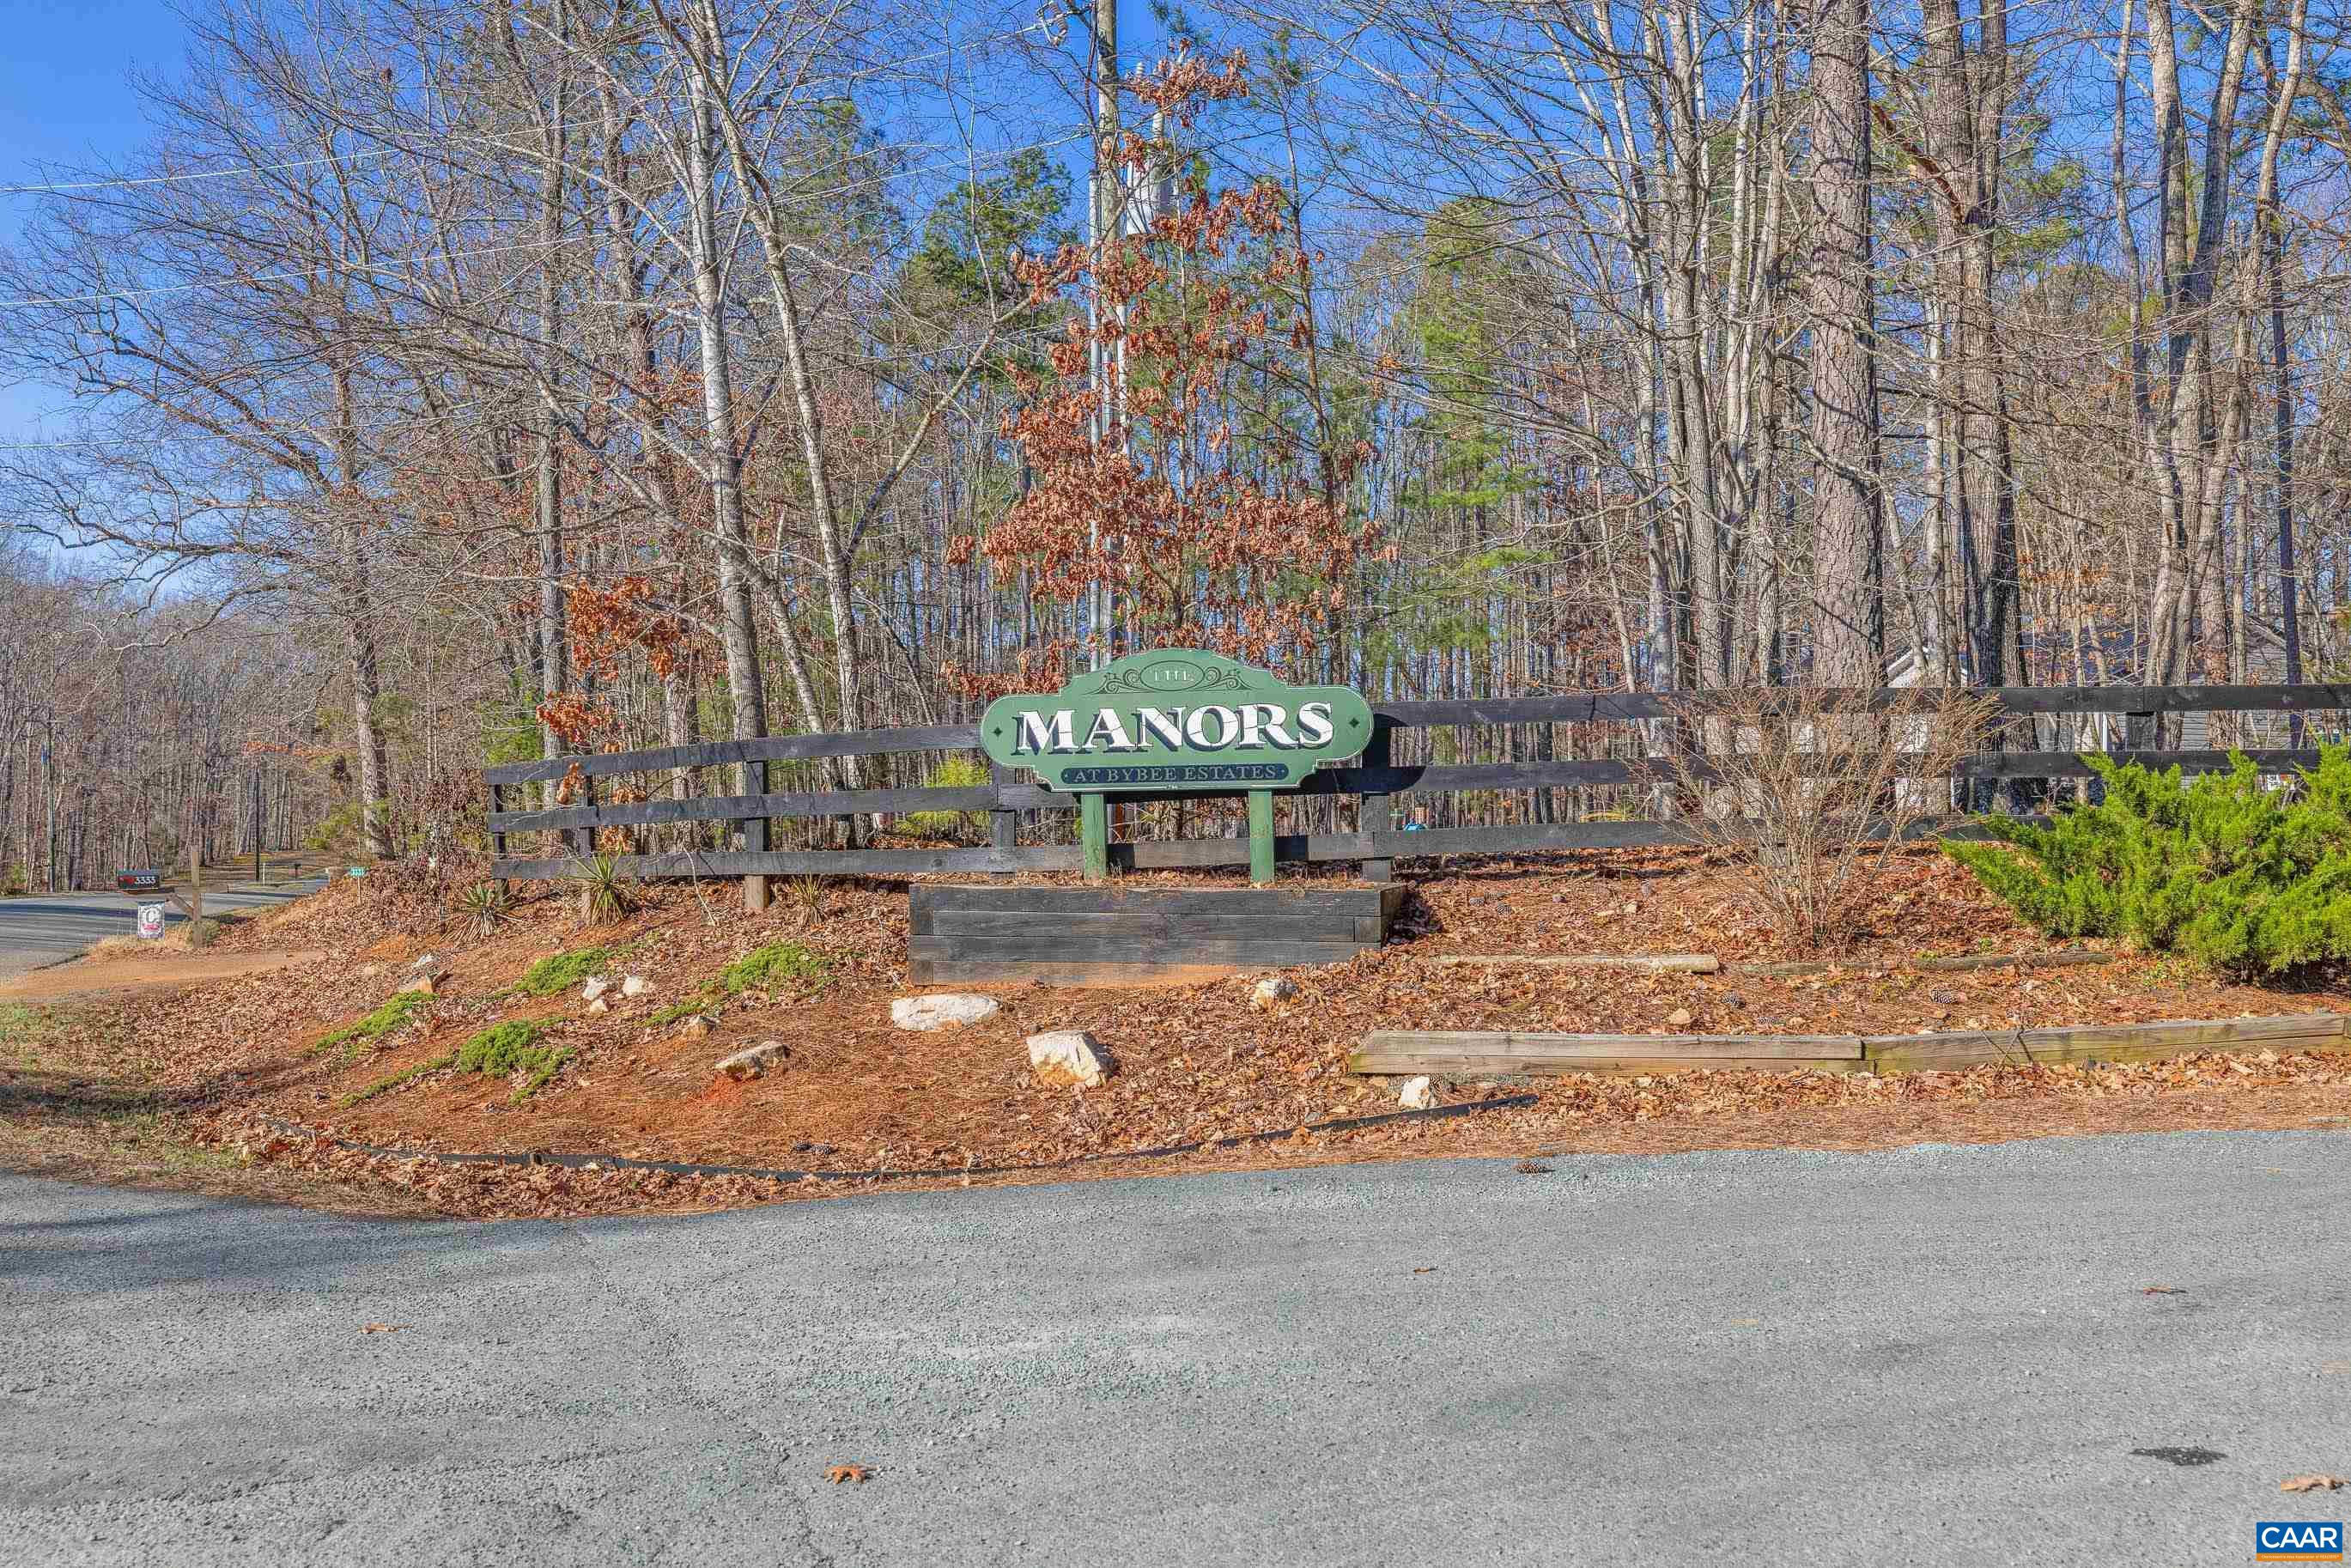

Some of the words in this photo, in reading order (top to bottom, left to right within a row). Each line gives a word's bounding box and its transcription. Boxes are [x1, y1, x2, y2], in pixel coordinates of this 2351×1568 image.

[1011, 702, 1333, 755] MANORS
[1073, 769, 1102, 783] AT
[1108, 768, 1176, 783] BYBEE
[1185, 764, 1277, 781] ESTATES
[134, 876, 155, 884] 3333
